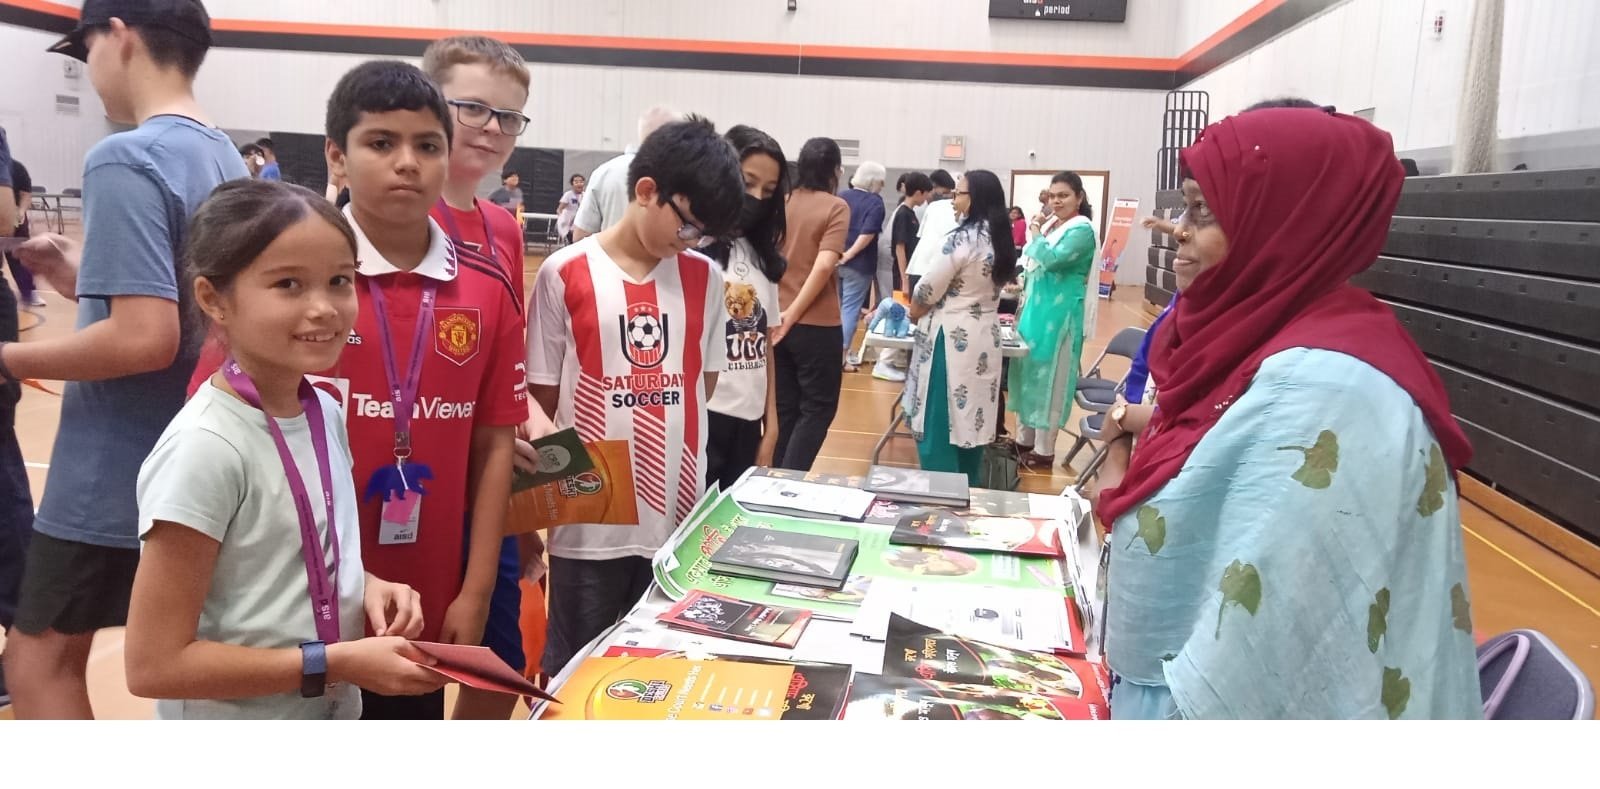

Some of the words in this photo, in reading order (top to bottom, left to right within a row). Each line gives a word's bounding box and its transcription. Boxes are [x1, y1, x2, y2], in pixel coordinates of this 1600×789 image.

[1043, 5, 1070, 16] period
[602, 373, 684, 391] SATURDAY
[352, 392, 476, 419] TeaViewe
[612, 391, 680, 408] SOCCER
